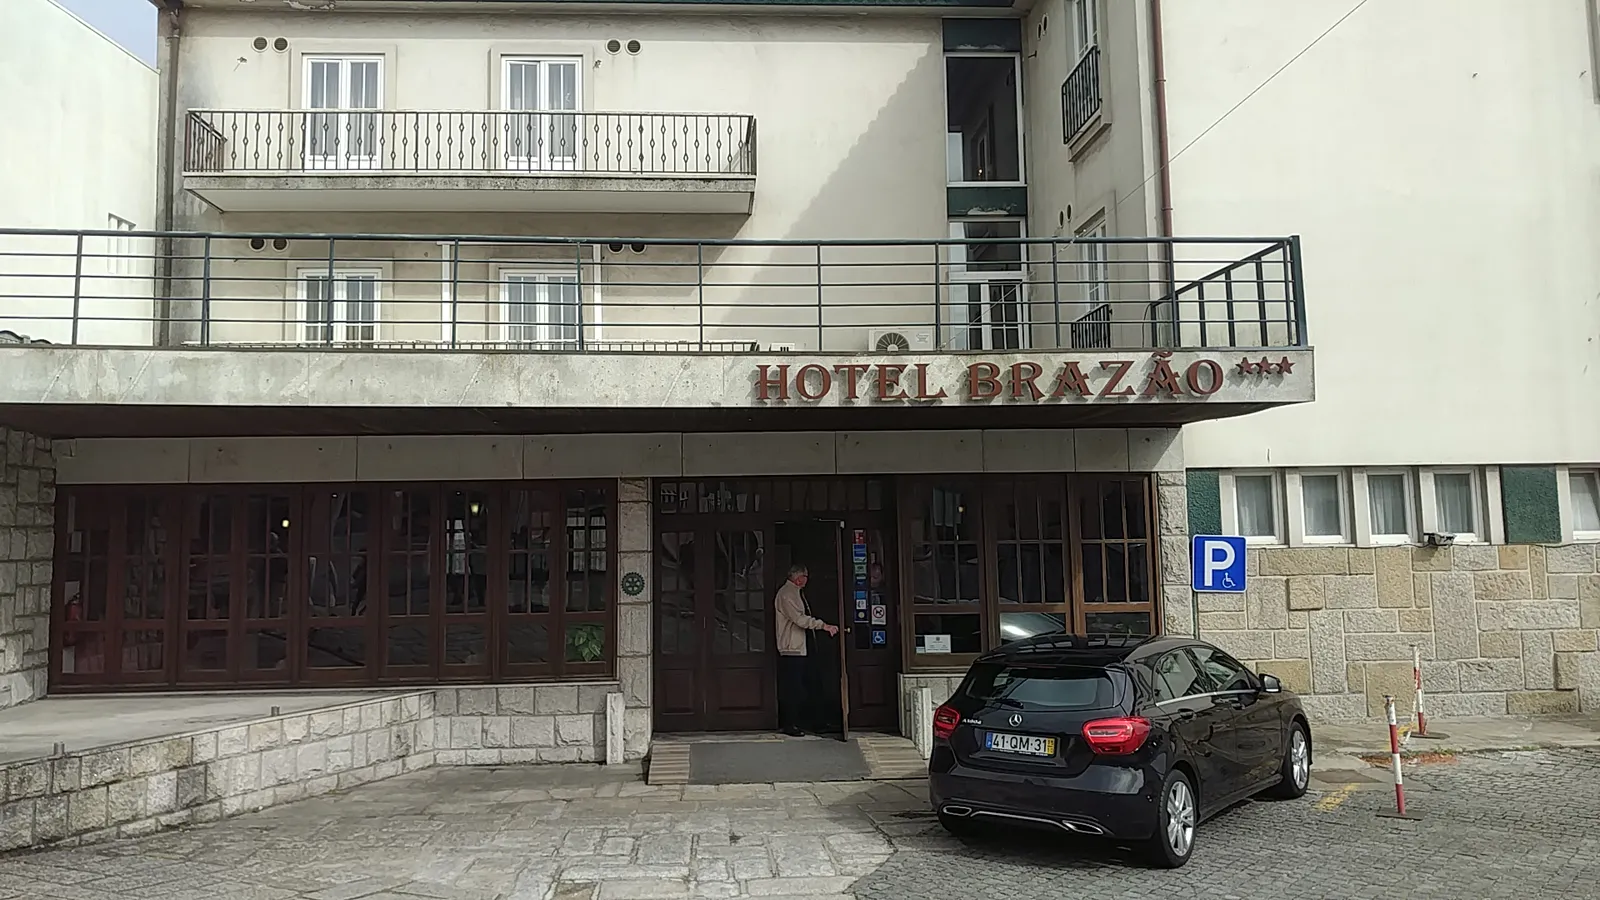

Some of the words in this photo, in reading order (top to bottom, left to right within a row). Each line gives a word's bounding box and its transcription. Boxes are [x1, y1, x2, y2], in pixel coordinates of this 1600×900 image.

[754, 363, 949, 400] HOTEL
[967, 351, 1224, 401] BRAZÃO
[1204, 540, 1236, 587] P
